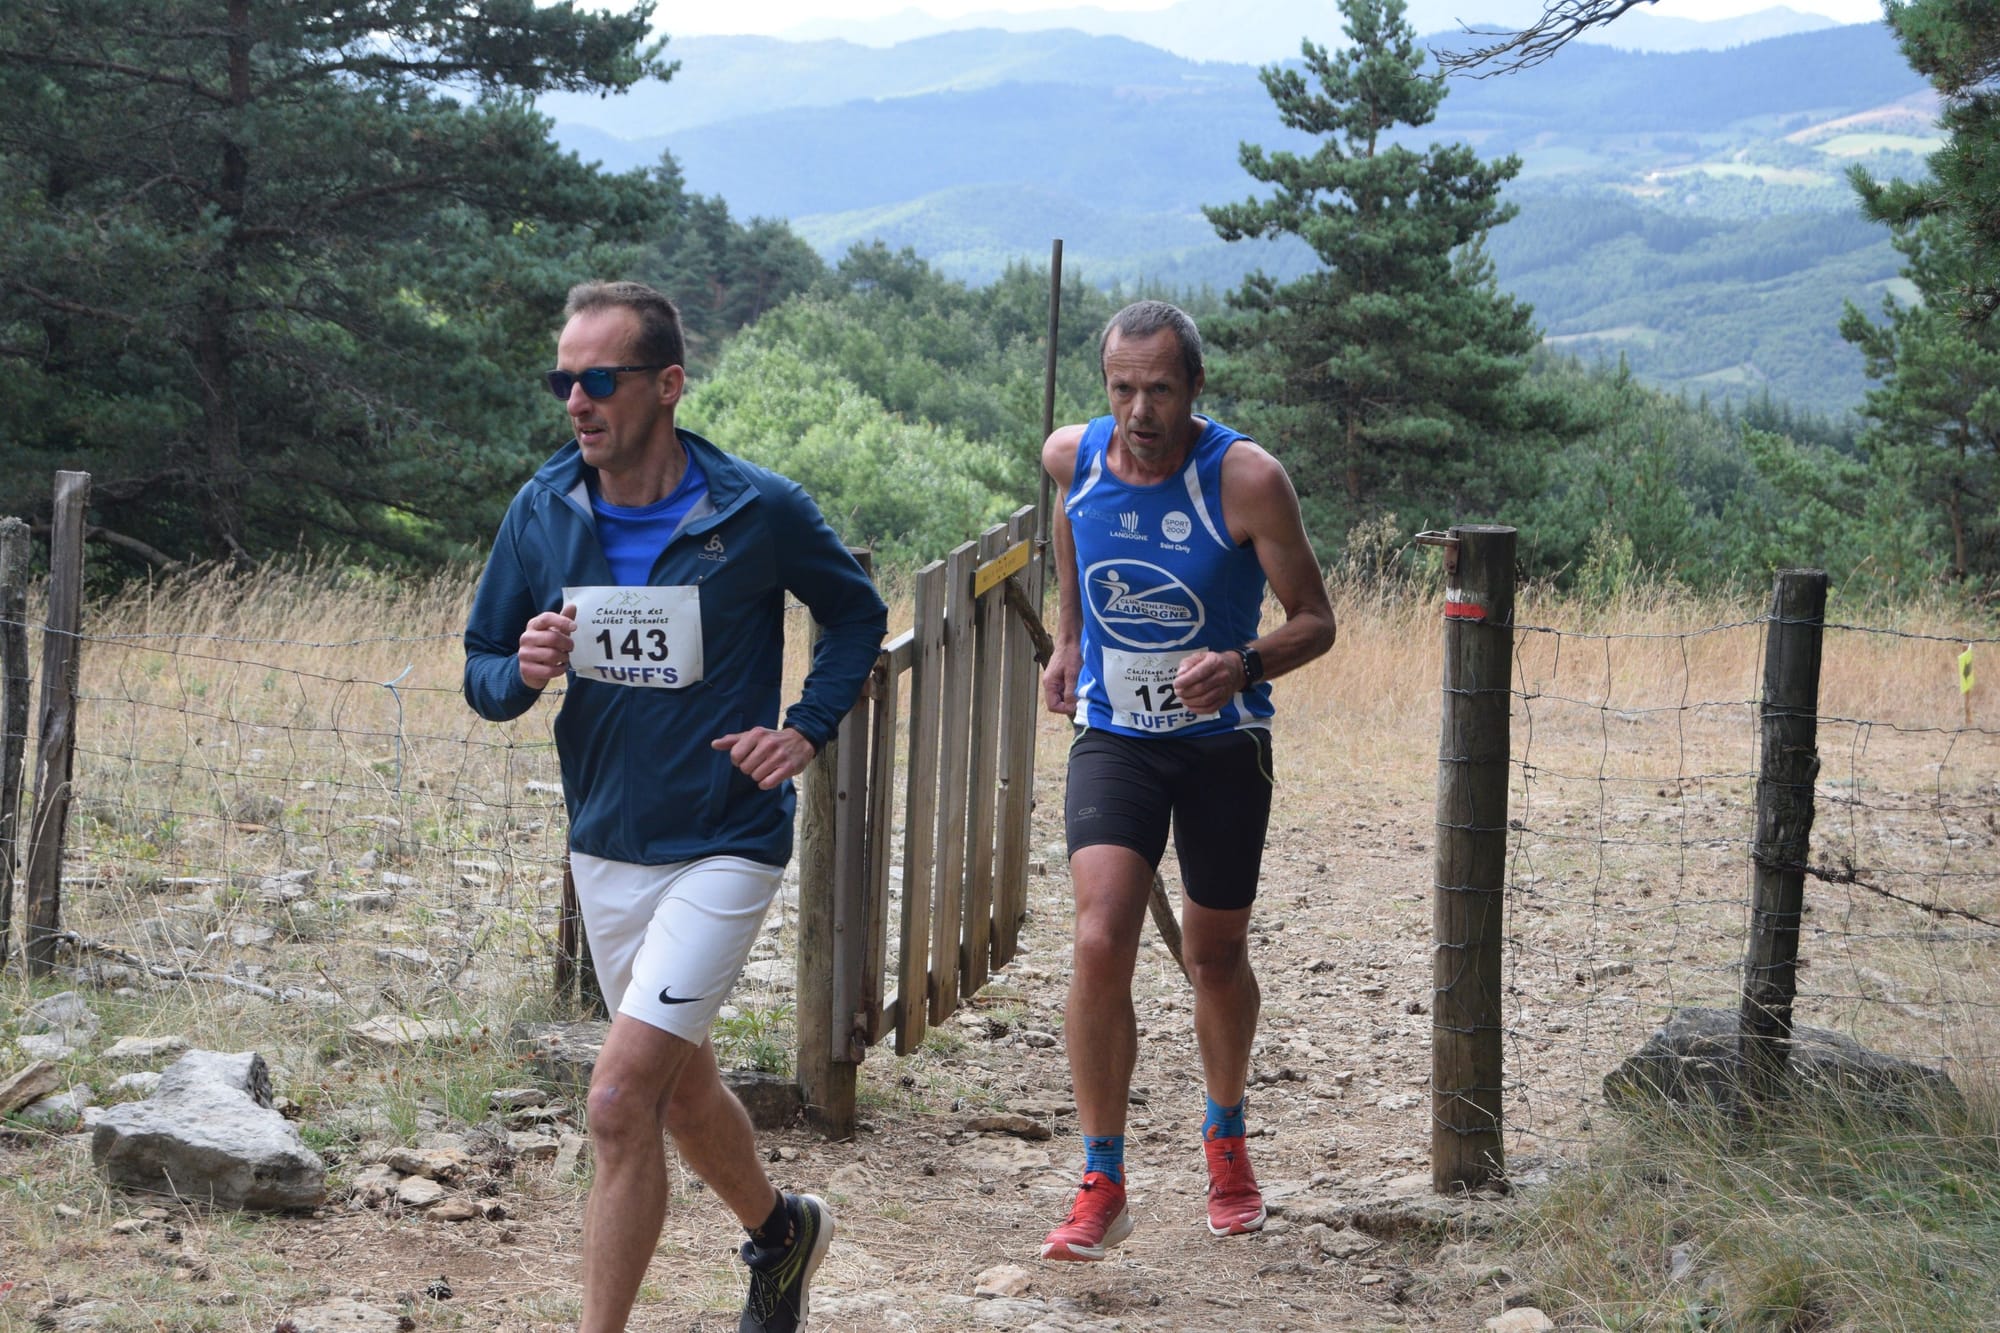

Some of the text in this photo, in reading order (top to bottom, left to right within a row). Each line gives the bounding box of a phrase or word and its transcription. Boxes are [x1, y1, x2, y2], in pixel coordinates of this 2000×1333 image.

[1165, 518, 1189, 527] SPORT
[1166, 526, 1186, 534] 2000
[1110, 531, 1148, 541] LANGOGNE
[596, 607, 642, 617] Challenge
[1116, 603, 1188, 619] LANGOGNE
[592, 616, 669, 625] vallées cévenoles
[595, 628, 669, 662] 143
[593, 665, 679, 684] TUFF'S
[1126, 667, 1164, 677] Challenge
[1129, 710, 1197, 729] TUFF'S
